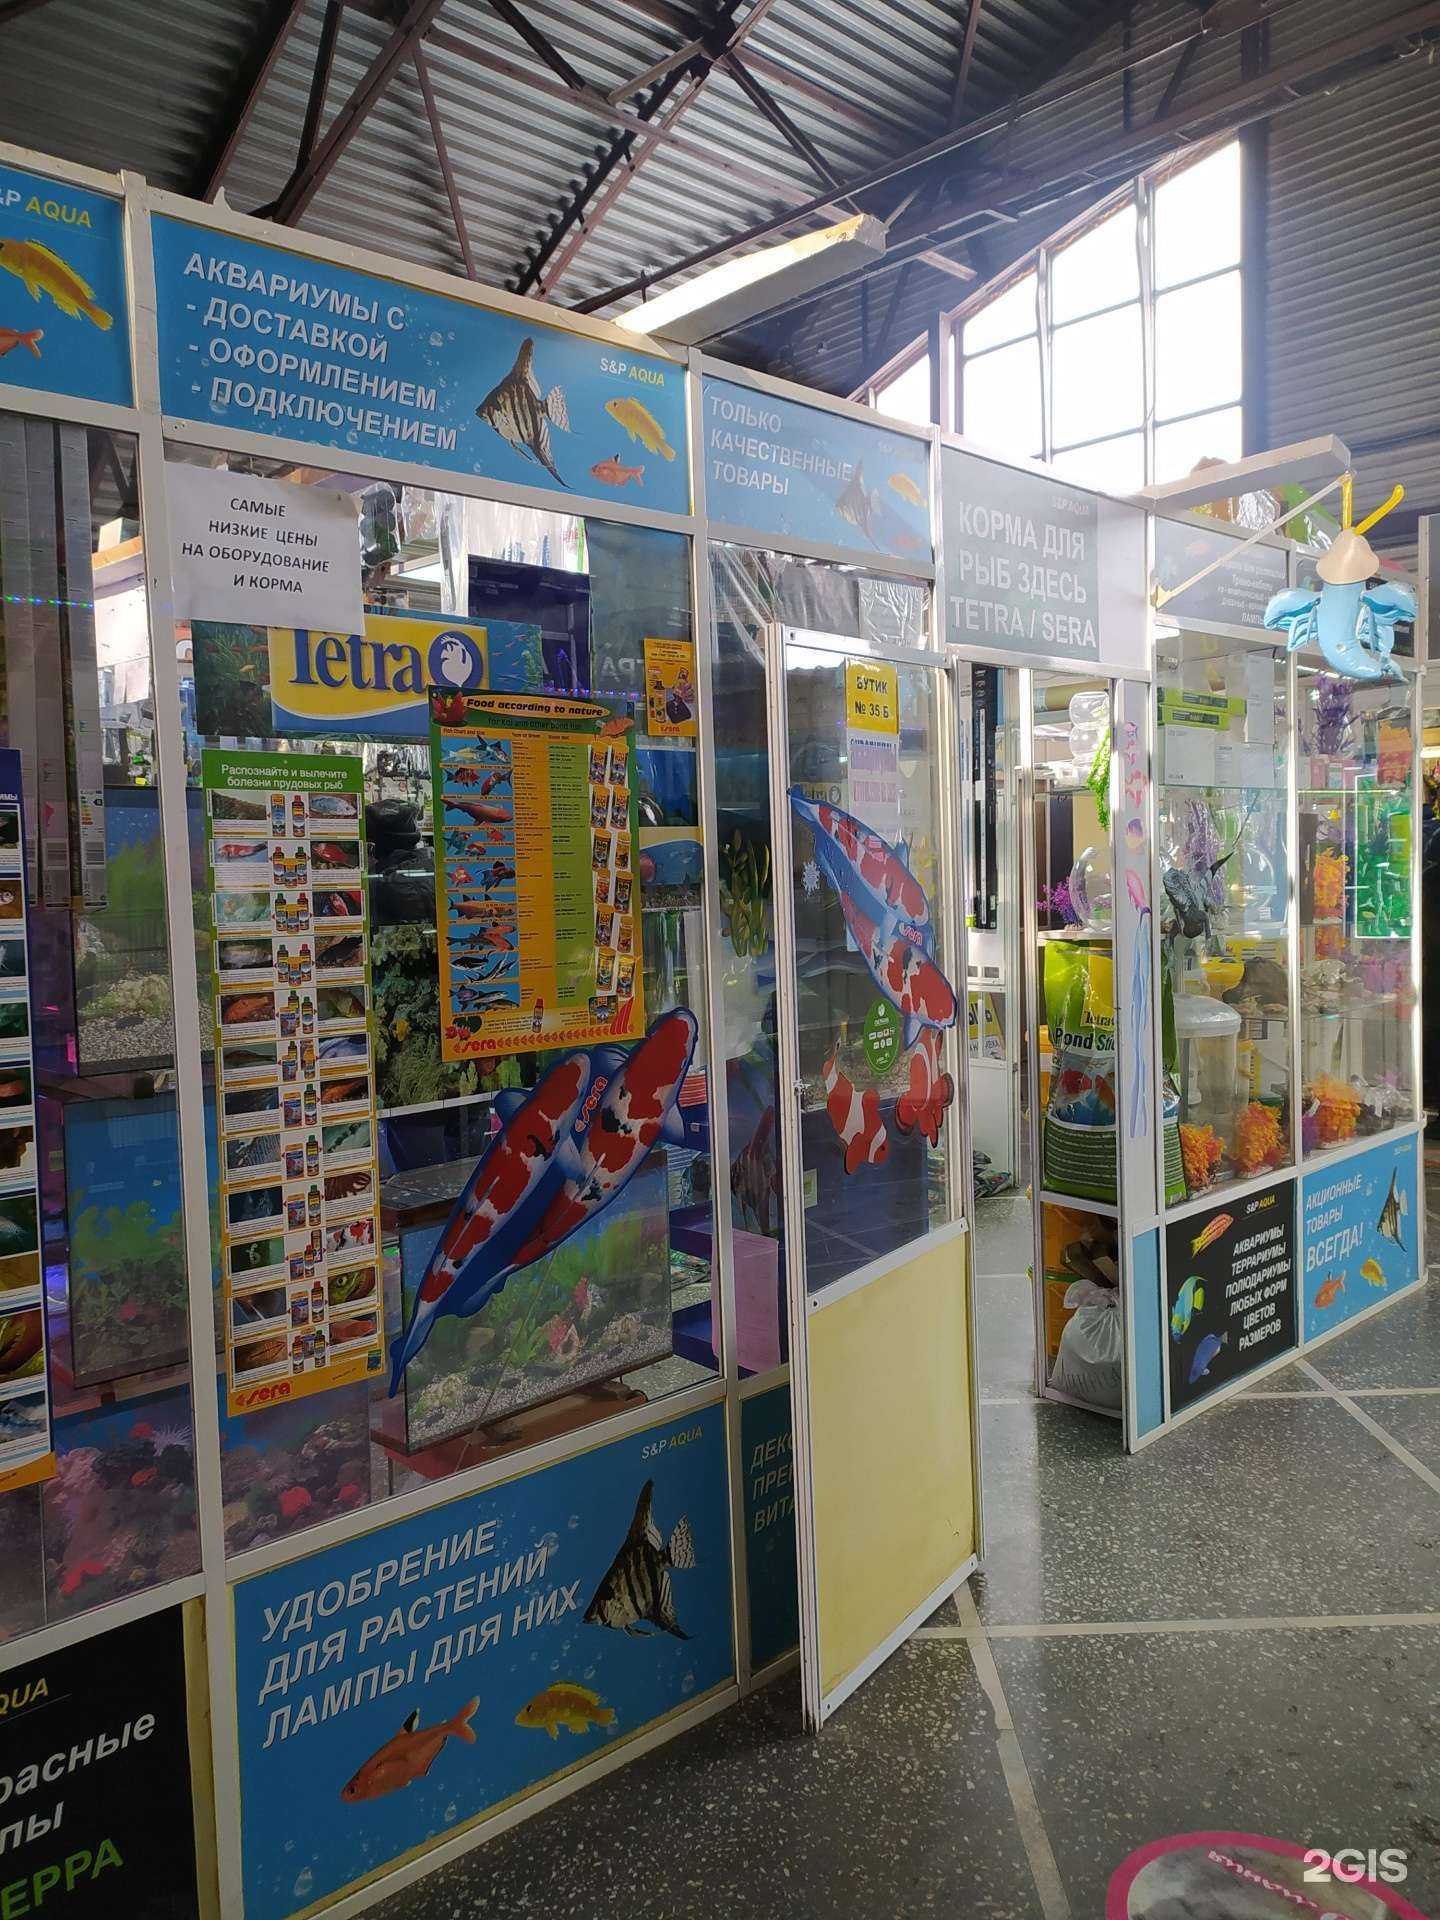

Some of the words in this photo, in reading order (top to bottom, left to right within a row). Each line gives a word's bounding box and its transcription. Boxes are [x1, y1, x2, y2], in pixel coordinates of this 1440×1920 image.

[25, 196, 92, 228] AQUA
[184, 253, 379, 324] АКВАРИУМЫ
[387, 307, 406, 330] С
[203, 297, 389, 364] ДОСТАВКОЙ
[209, 338, 438, 411] ОФОРМЛЕНИЕМ
[600, 357, 627, 376] S&P
[628, 367, 665, 386] AQUA
[211, 377, 458, 451] ПОДКЛЮЧЕНИЕМ
[710, 396, 782, 433] ТОЛЬКО
[711, 428, 853, 482] КАЧЕСТВЕННЫЕ
[712, 460, 789, 496] ТОВАРЫ
[230, 497, 286, 517] САМЫЕ
[208, 520, 268, 540] НИЗКИЕ
[275, 530, 318, 547] ЦЕНЫ
[959, 501, 1038, 551] КОРМА
[1043, 524, 1085, 561] ДЛЯ
[181, 542, 204, 558] НА
[208, 545, 330, 573] ОБОРУДОВАНИЕ
[233, 574, 244, 587] И
[249, 575, 303, 593] КОРМА
[960, 550, 1012, 590] РЫБ
[1017, 561, 1087, 604] ЗДЕСЬ
[949, 596, 1025, 638] TETRA
[1041, 610, 1097, 648] SERA
[856, 676, 888, 694] БУТИК
[466, 698, 495, 708] Food
[497, 701, 551, 714] according
[554, 704, 566, 713] to
[568, 706, 603, 717] nature
[854, 700, 866, 715] №
[869, 703, 881, 717] 35
[221, 764, 288, 777] Распознайте
[291, 769, 298, 777] и
[299, 769, 348, 779] вылечите
[227, 777, 272, 787] болезни
[274, 778, 322, 790] прудовых
[324, 781, 343, 791] рыб
[461, 1037, 497, 1051] sera
[1054, 1026, 1093, 1050] Pond
[1258, 1194, 1276, 1209] AQUA
[1306, 1173, 1362, 1212] АКЦИОННЫЕ
[1306, 1205, 1344, 1235] ТОВАРЫ
[1232, 1223, 1285, 1256] АКВАРИУМЫ
[1306, 1221, 1364, 1273] ВСЕГДА!
[1231, 1241, 1286, 1276] ТЕРРАРИУМЫ
[1225, 1258, 1291, 1299] ПОЛЮДАРИУМЫ
[1229, 1290, 1262, 1316] ЛЮБЫХ
[1263, 1278, 1288, 1301] ФОРМ
[1243, 1302, 1276, 1330] ЦВЕТОВ
[1238, 1318, 1281, 1351] РАЗМЕРОВ
[246, 1382, 291, 1405] sera
[641, 1440, 667, 1461] S&P
[668, 1425, 703, 1450] AQUA
[262, 1519, 498, 1643] УДОБРЕНИЕ
[258, 1627, 348, 1705] ДЛЯ
[358, 1541, 549, 1654] РАСТЕНИЙ
[262, 1650, 417, 1749] ЛАМПЫ
[424, 1613, 501, 1684] ДЛЯ
[512, 1579, 582, 1639] НИХ
